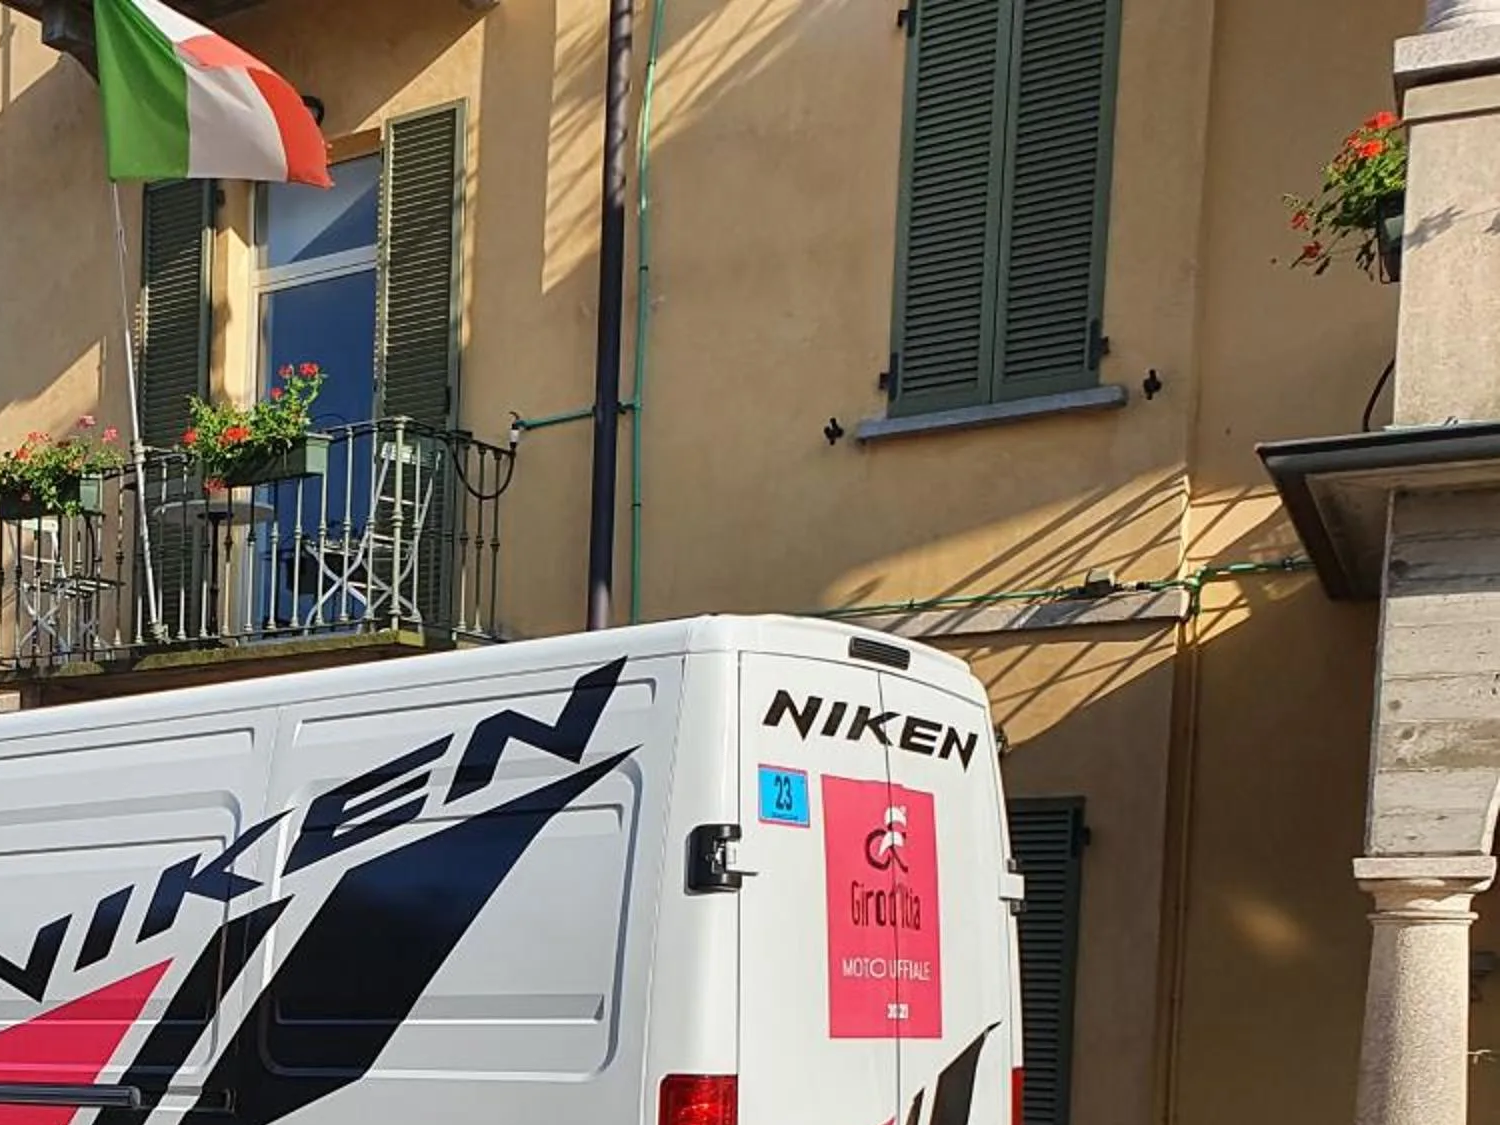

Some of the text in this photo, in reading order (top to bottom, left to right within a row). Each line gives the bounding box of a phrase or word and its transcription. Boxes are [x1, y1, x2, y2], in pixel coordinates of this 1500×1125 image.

[762, 688, 978, 772] NIKEN
[773, 774, 793, 811] 23
[842, 957, 887, 979] MOTO
